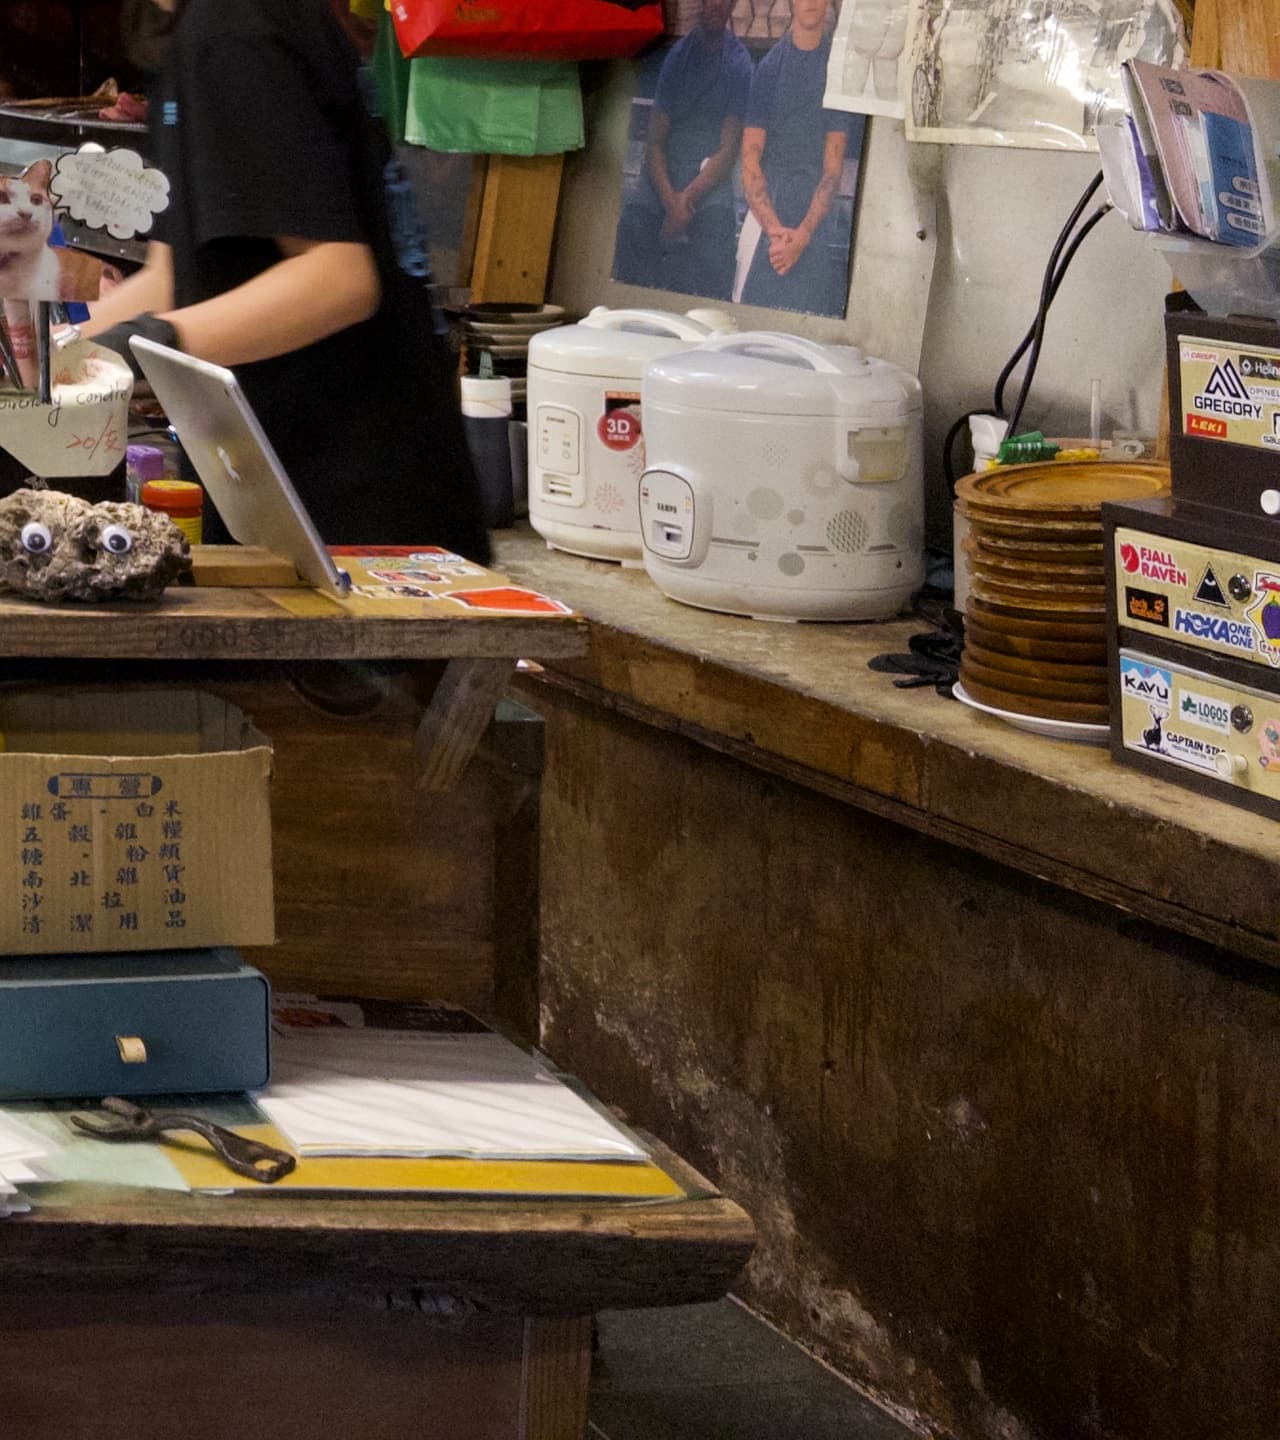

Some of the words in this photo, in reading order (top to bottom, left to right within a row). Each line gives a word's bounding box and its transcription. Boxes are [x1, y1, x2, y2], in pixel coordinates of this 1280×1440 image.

[1194, 395, 1262, 419] GREGORY
[607, 418, 630, 433] 3D
[1191, 418, 1223, 433] LEKI
[1141, 564, 1187, 586] RAVEN
[1175, 610, 1231, 643] HOKA
[1229, 623, 1251, 637] ONE
[1231, 635, 1254, 649] ONE
[1125, 675, 1168, 700] KAVU
[1198, 702, 1228, 722] LOGOS
[1166, 732, 1204, 752] CAPTAIN
